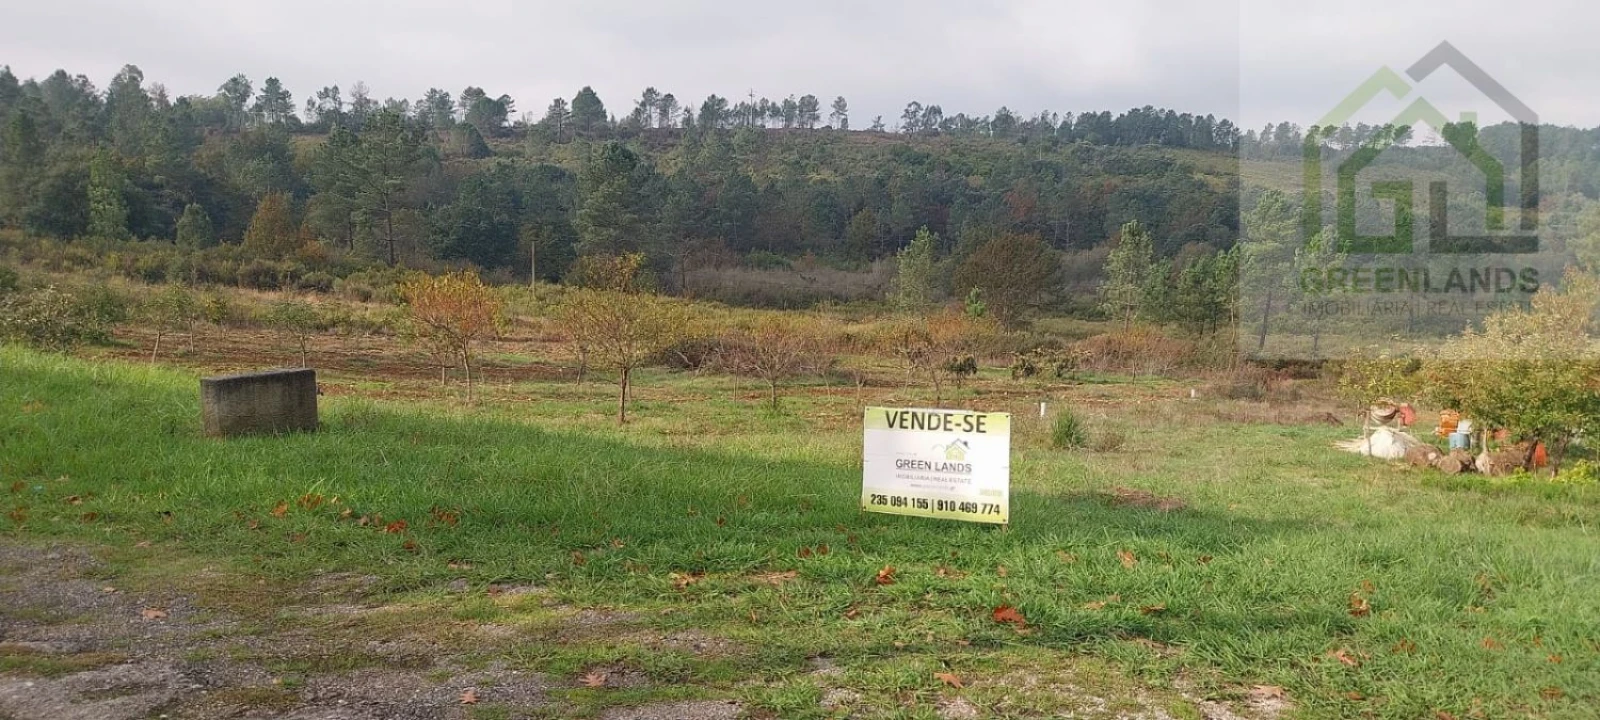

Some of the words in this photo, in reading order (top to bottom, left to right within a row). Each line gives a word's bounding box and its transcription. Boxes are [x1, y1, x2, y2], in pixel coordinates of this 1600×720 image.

[885, 410, 988, 434] VENDE-SE
[896, 459, 932, 471] GREEN
[935, 462, 973, 474] LANDS
[870, 494, 888, 506] 235
[890, 496, 908, 508] 094
[911, 498, 929, 510] 155
[937, 500, 956, 512] 910
[958, 502, 978, 514] 469
[981, 503, 1001, 516] 774
